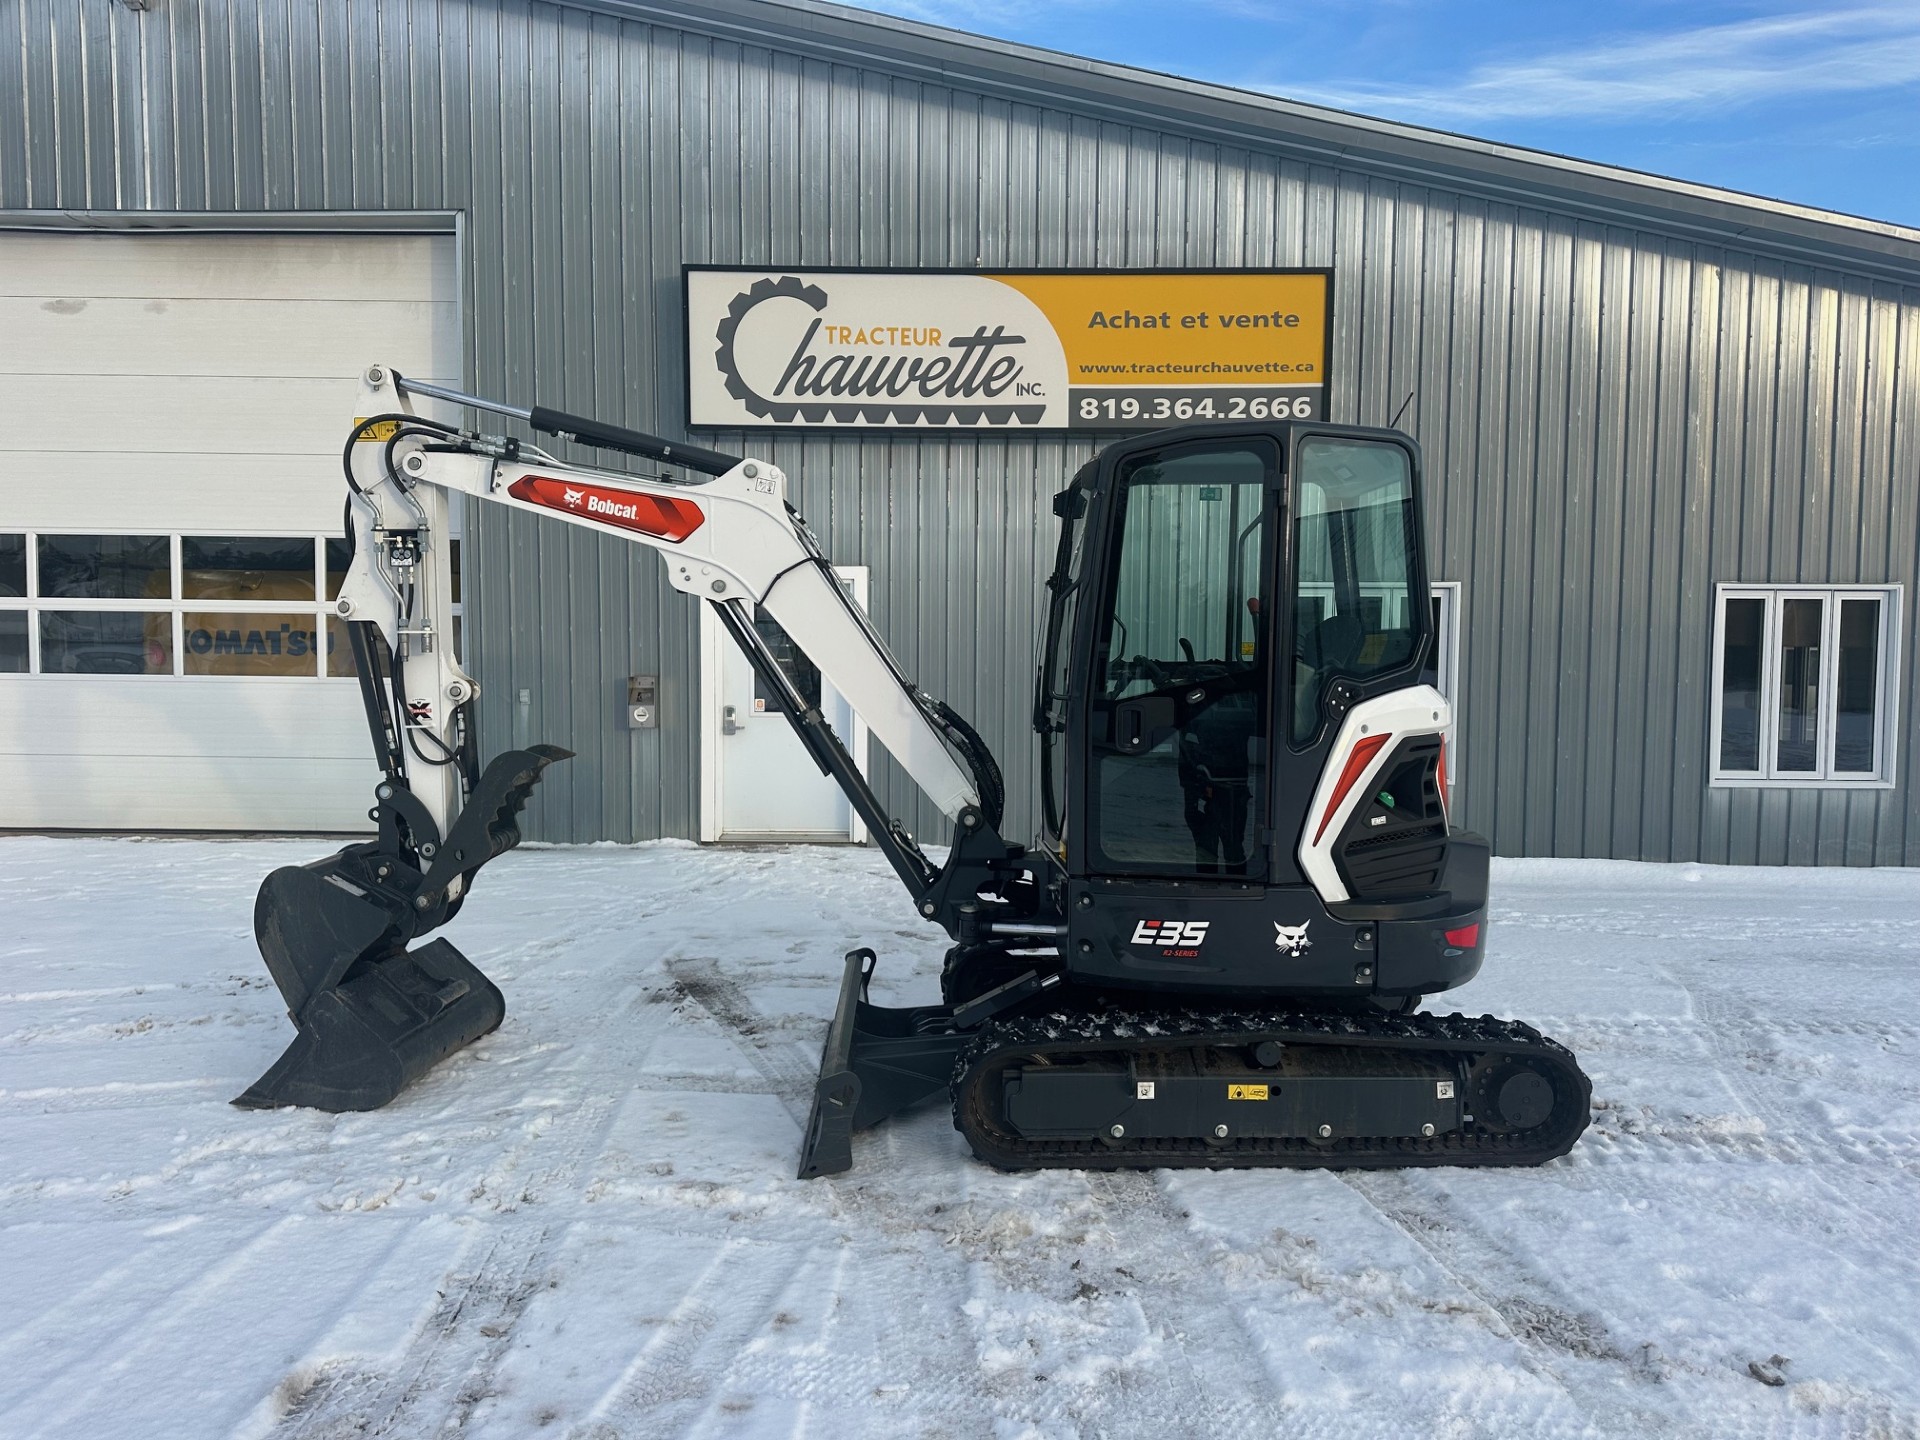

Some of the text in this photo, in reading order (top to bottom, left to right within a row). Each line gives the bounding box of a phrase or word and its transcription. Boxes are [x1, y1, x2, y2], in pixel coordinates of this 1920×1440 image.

[1088, 310, 1300, 329] Achat et vente
[715, 276, 1045, 418] Chauvette INC.
[825, 326, 941, 346] TRACTEUR
[1079, 362, 1314, 374] www.tracteurchauvette.ca
[1079, 396, 1312, 419] 819.364.2666
[587, 495, 637, 520] Bobcat
[1130, 920, 1210, 946] E35
